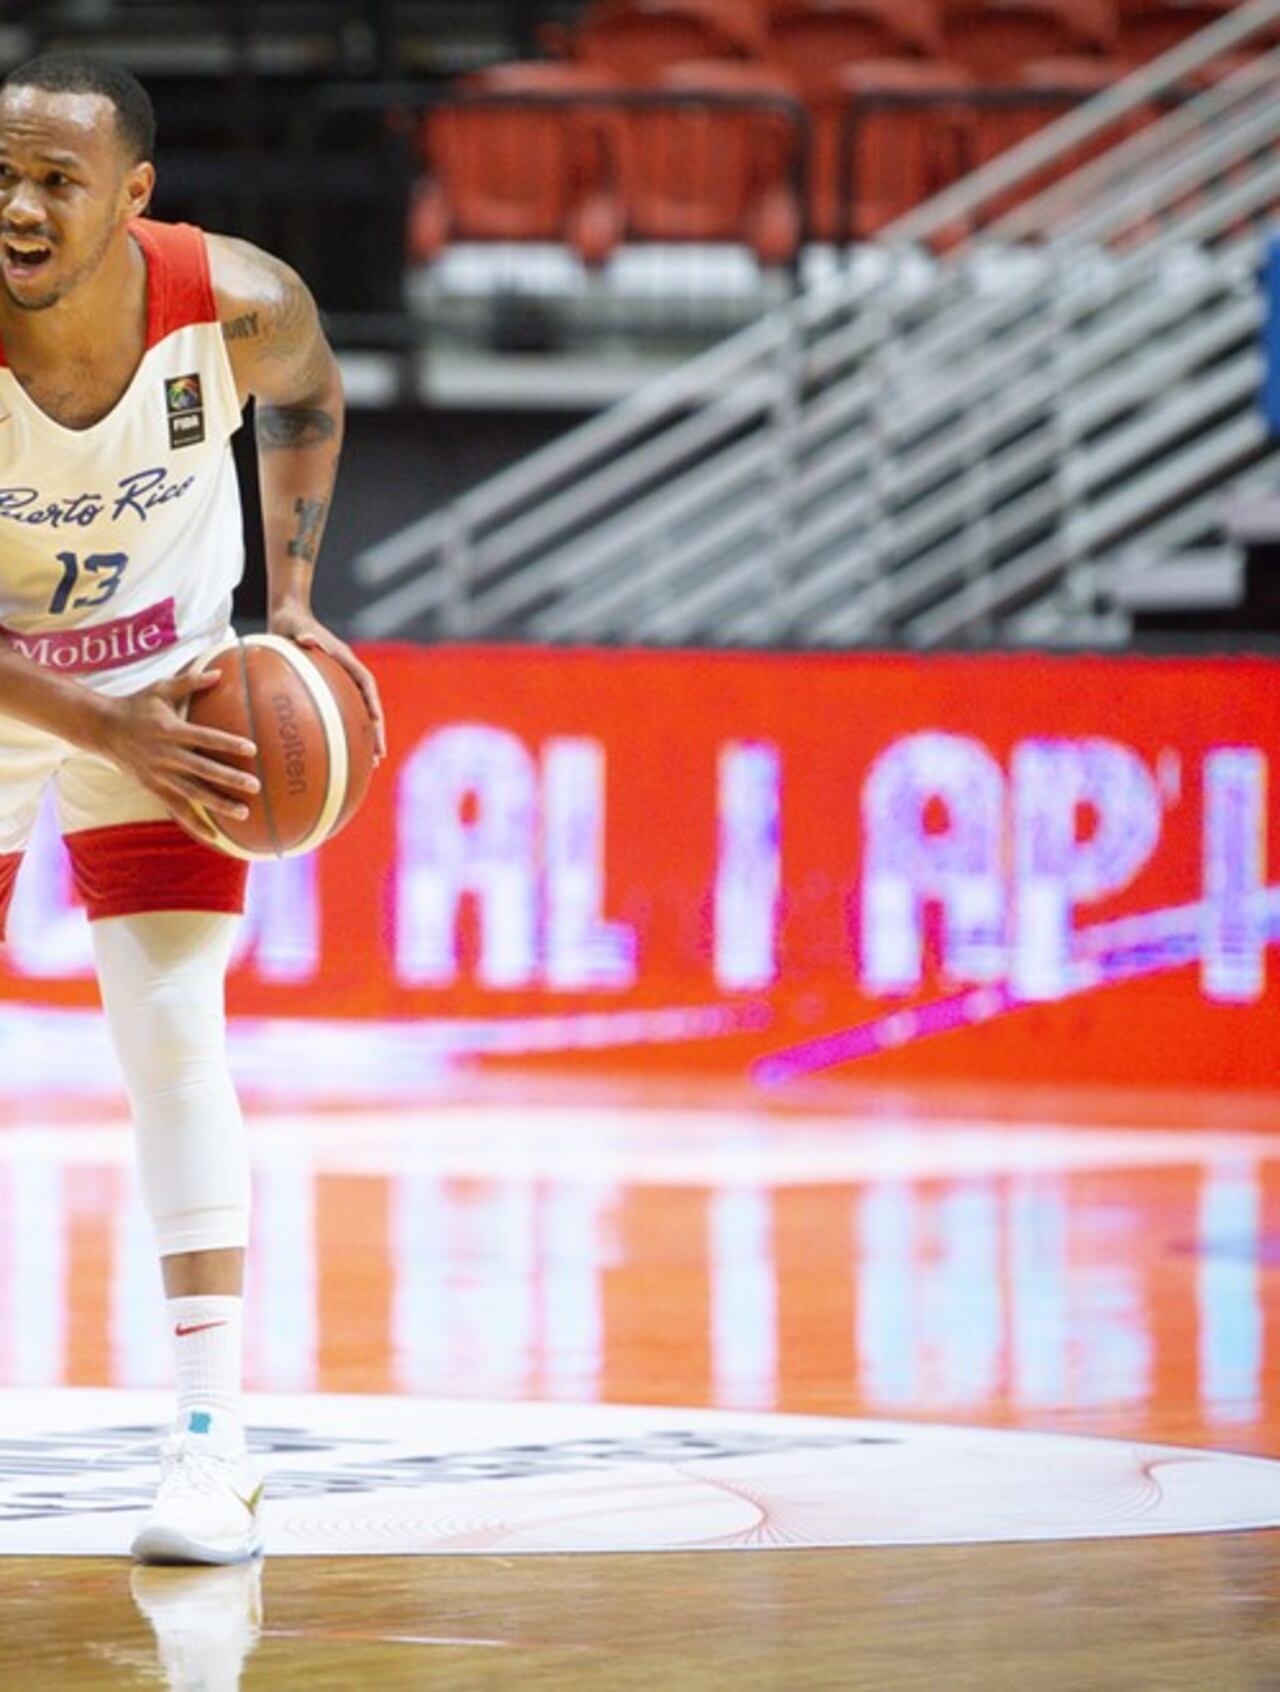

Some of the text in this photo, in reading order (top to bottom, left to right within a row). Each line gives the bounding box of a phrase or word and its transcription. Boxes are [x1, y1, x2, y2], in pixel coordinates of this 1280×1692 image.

[112, 466, 195, 522] Rico
[48, 550, 129, 616] 13
[12, 619, 162, 669] Mobile
[273, 694, 308, 797] molten
